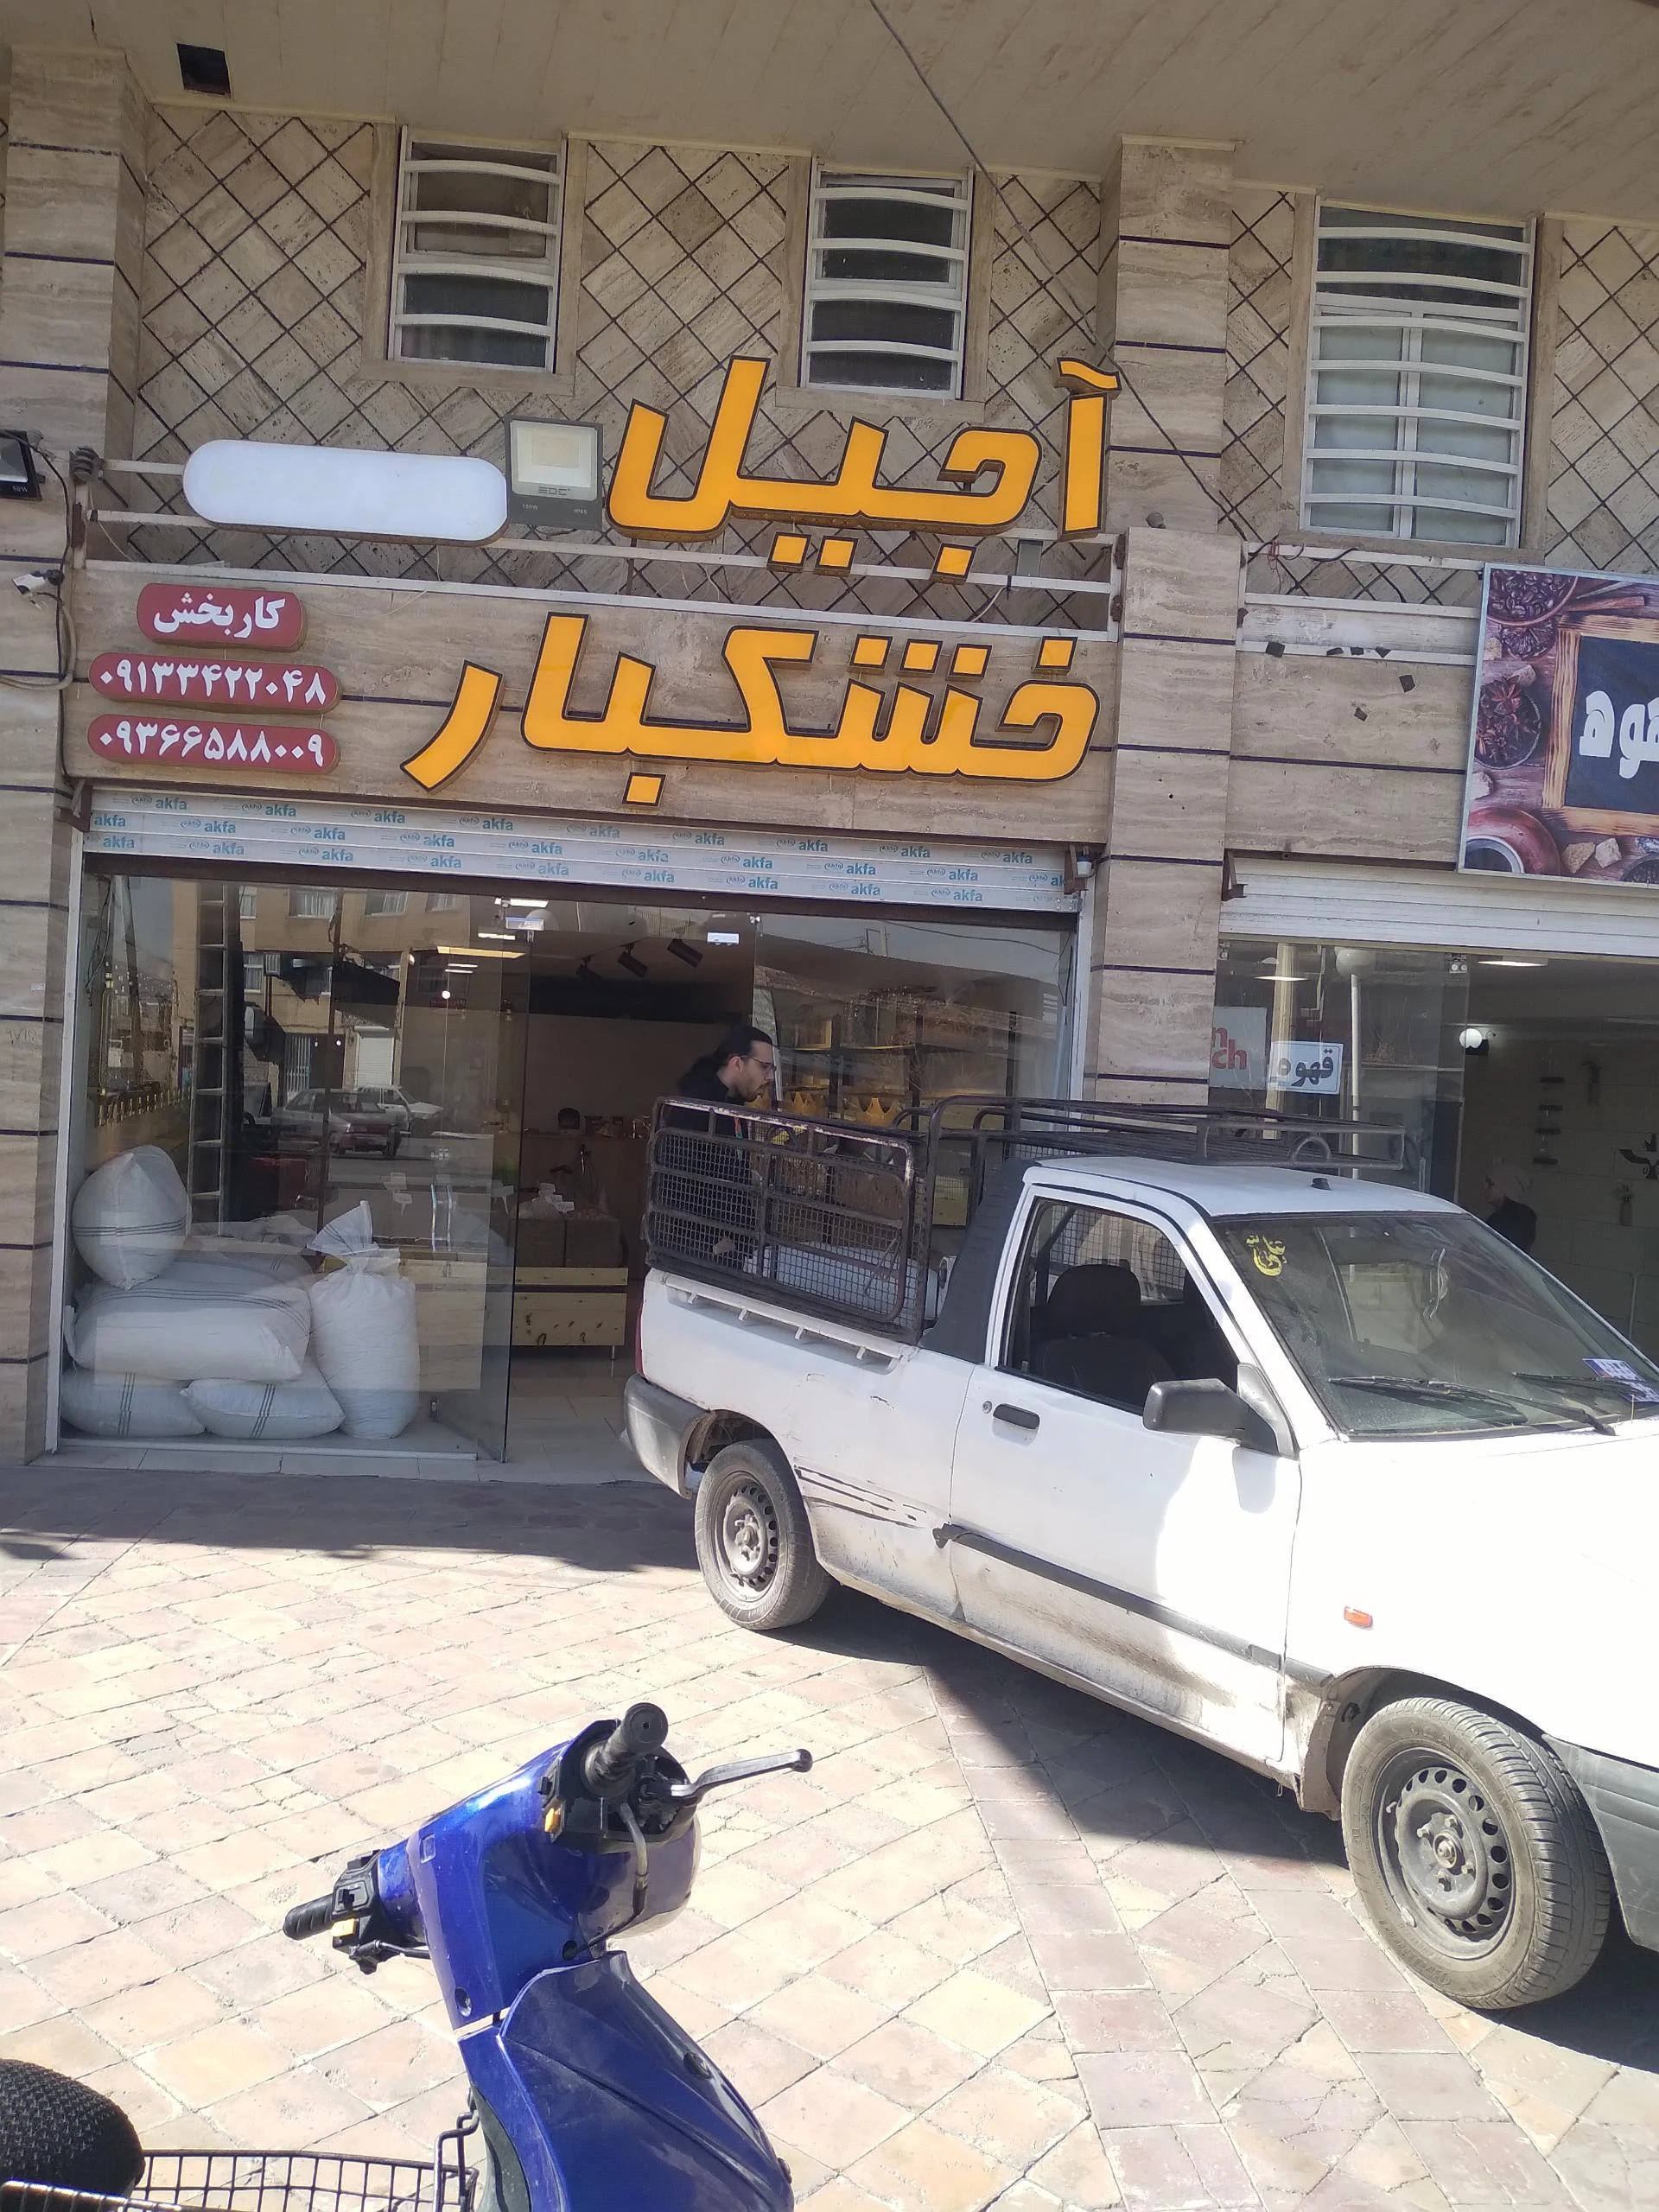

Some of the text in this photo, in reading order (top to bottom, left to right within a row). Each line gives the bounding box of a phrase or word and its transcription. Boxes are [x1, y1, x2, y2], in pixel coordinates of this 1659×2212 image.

[607, 356, 1121, 576] آجیل
[154, 592, 286, 639] کاربخش
[99, 658, 327, 705] ۰۹۱۳۳۴۲۲۰۴۸
[400, 612, 1100, 806] خشکبار
[99, 720, 324, 767] ۰۹۳۶۶۵۸۸۰۰۹
[94, 813, 126, 827] akfa
[204, 820, 236, 834] akfa
[314, 827, 346, 841] akfa
[423, 835, 454, 848] akfa
[531, 842, 563, 855] akfa
[742, 856, 772, 869] akfa
[846, 862, 876, 875] akfa
[949, 868, 978, 881] akfa
[156, 797, 188, 810] akfa
[265, 804, 296, 817] akfa
[374, 810, 406, 824] akfa
[482, 817, 513, 830] akfa
[589, 825, 620, 838] akfa
[695, 832, 725, 846] akfa
[798, 839, 829, 852] akfa
[900, 845, 931, 858] akfa
[1002, 851, 1033, 864] akfa
[103, 835, 135, 849] akfa
[213, 842, 245, 855] akfa
[321, 849, 353, 861] akfa
[430, 855, 461, 868] akfa
[538, 862, 569, 875] akfa
[644, 870, 675, 883] akfa
[747, 876, 779, 890] akfa
[850, 883, 880, 896] akfa
[953, 889, 982, 902] akfa
[1278, 1048, 1334, 1087] قهوه
